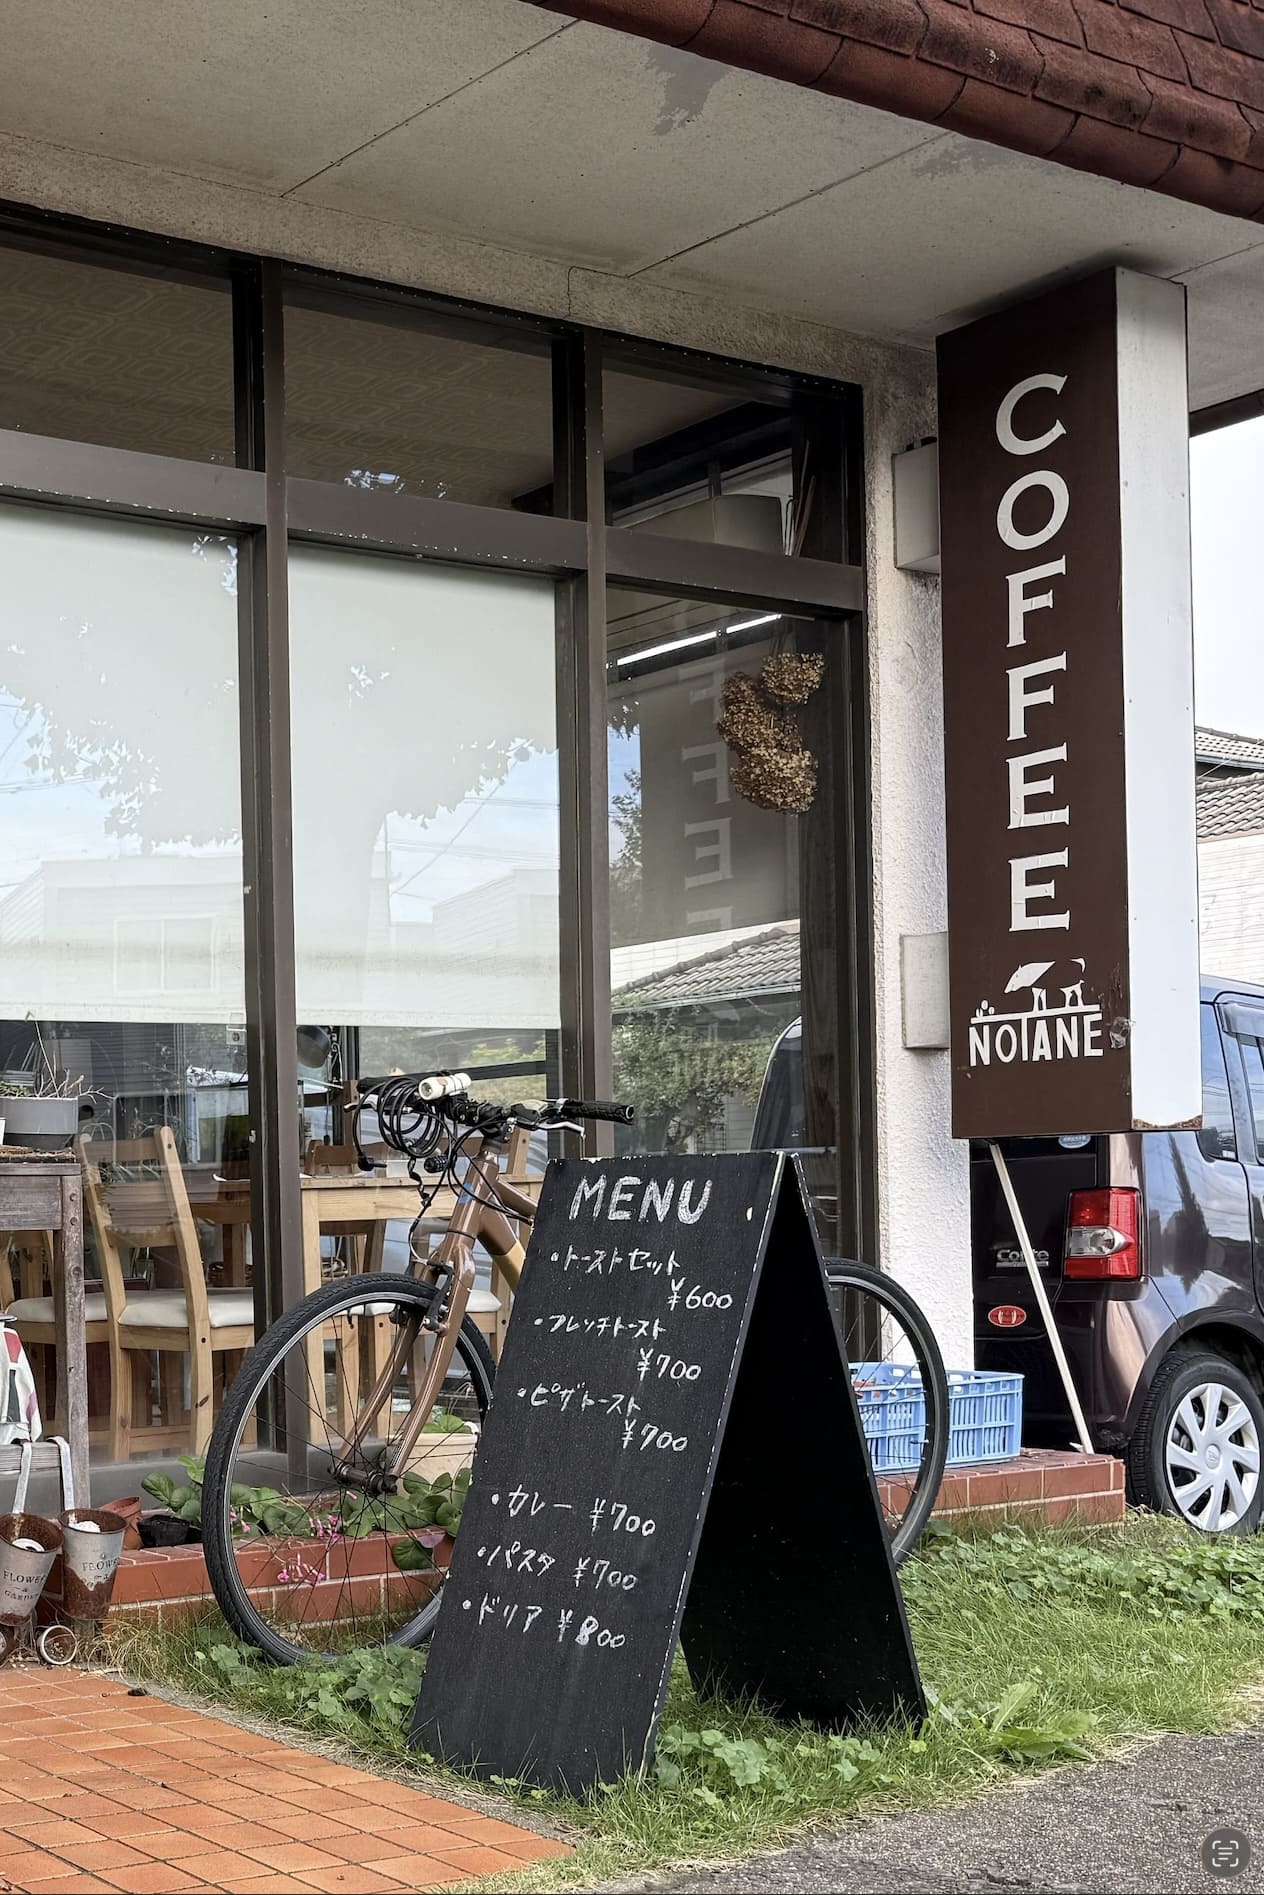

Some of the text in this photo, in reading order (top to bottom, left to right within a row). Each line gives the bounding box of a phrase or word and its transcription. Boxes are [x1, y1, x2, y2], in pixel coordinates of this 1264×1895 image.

[994, 373, 1070, 932] COFFEE
[969, 1005, 1104, 1067] NOTANE
[569, 1174, 713, 1225] MENU
[563, 1244, 681, 1276] トーストセット
[667, 1277, 733, 1311] ¥600
[637, 1348, 702, 1382] ¥700
[529, 1381, 641, 1417] ピザトースト
[622, 1418, 688, 1451] ¥700
[508, 1484, 656, 1536] カレー ¥700
[487, 1540, 638, 1590] パスタ ¥700
[478, 1592, 626, 1648] ドリア ¥800
